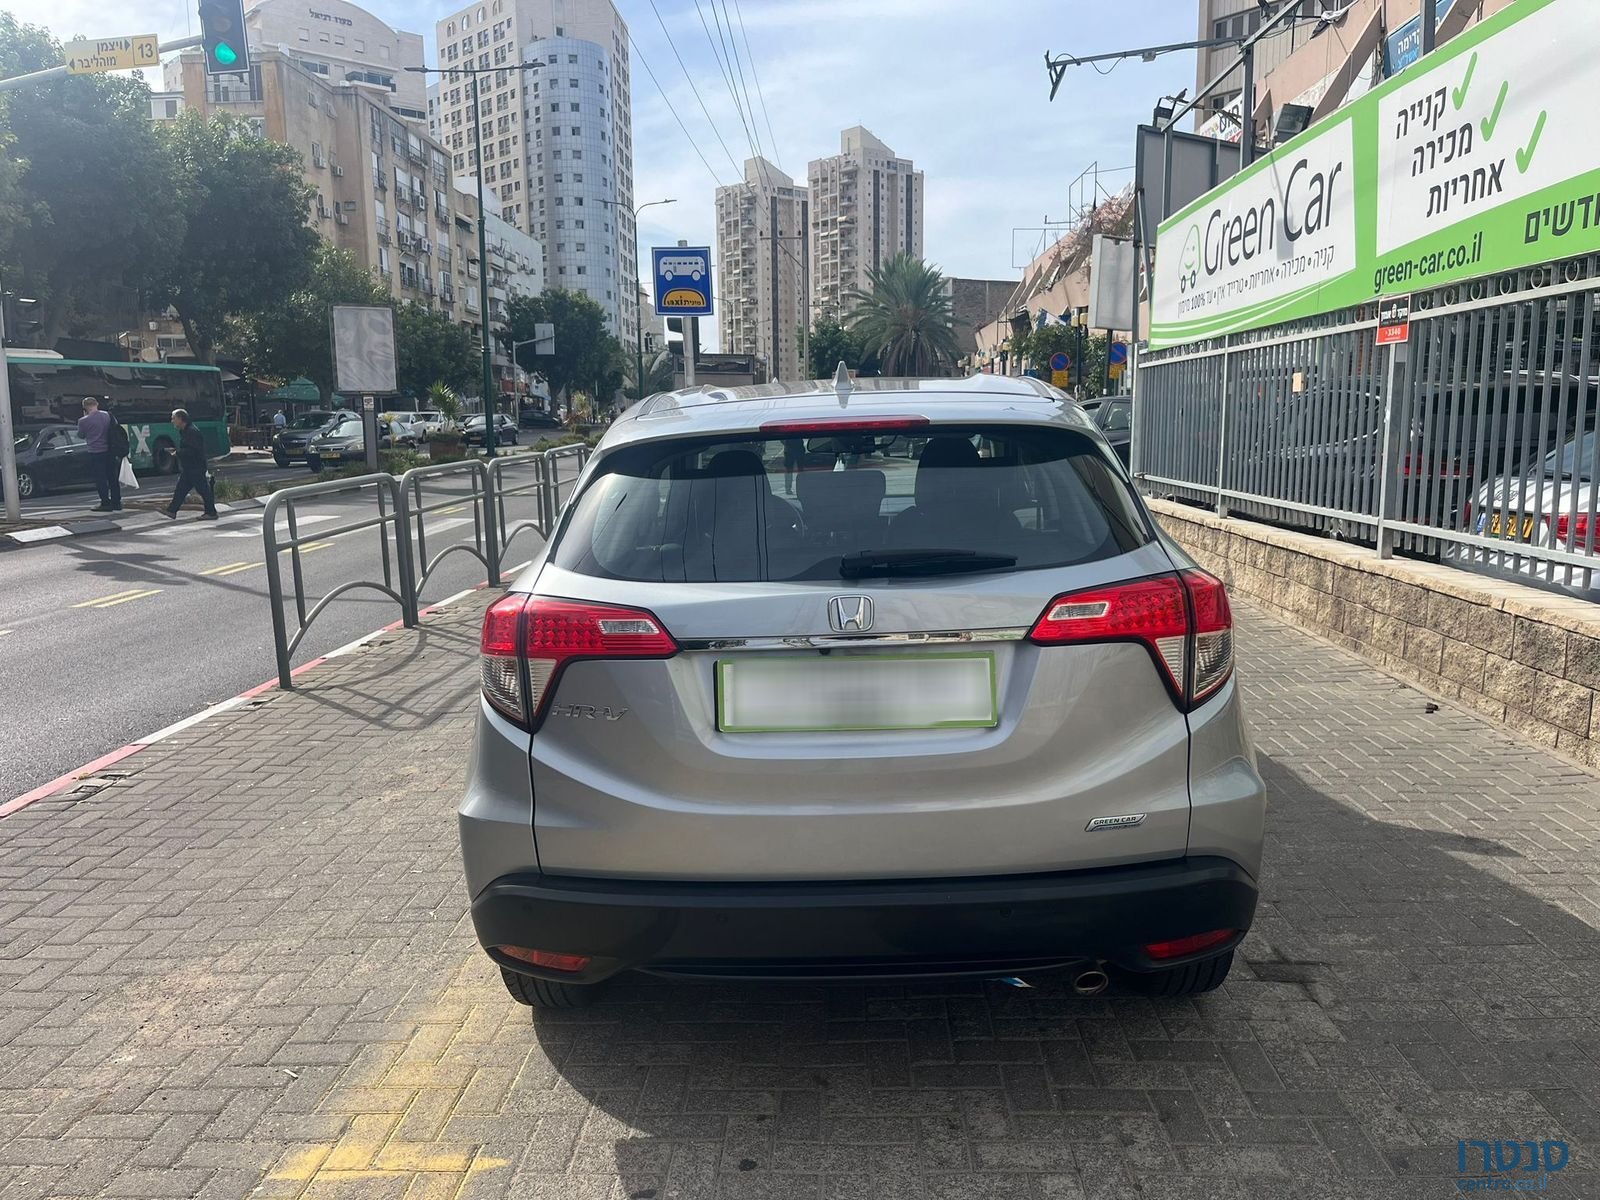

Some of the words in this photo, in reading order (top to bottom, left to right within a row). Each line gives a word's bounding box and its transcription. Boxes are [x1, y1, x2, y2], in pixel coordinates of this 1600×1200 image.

[96, 40, 123, 55] ויצמן
[138, 43, 153, 58] 13
[77, 54, 117, 68] מוהליבר
[1395, 86, 1447, 139] קנייה
[1411, 122, 1473, 177] מכירה
[1426, 158, 1506, 218] אחריות
[1204, 197, 1275, 276] Green
[1283, 158, 1343, 242] Car
[1524, 192, 1600, 244] דשים
[1280, 256, 1306, 279] מכירה
[1312, 245, 1335, 270] קניה
[1374, 231, 1483, 294] green-car.co.il
[1227, 278, 1244, 297] טרייד
[1249, 267, 1275, 291] אחריות
[667, 296, 683, 306] taxi
[1216, 284, 1226, 305] אין
